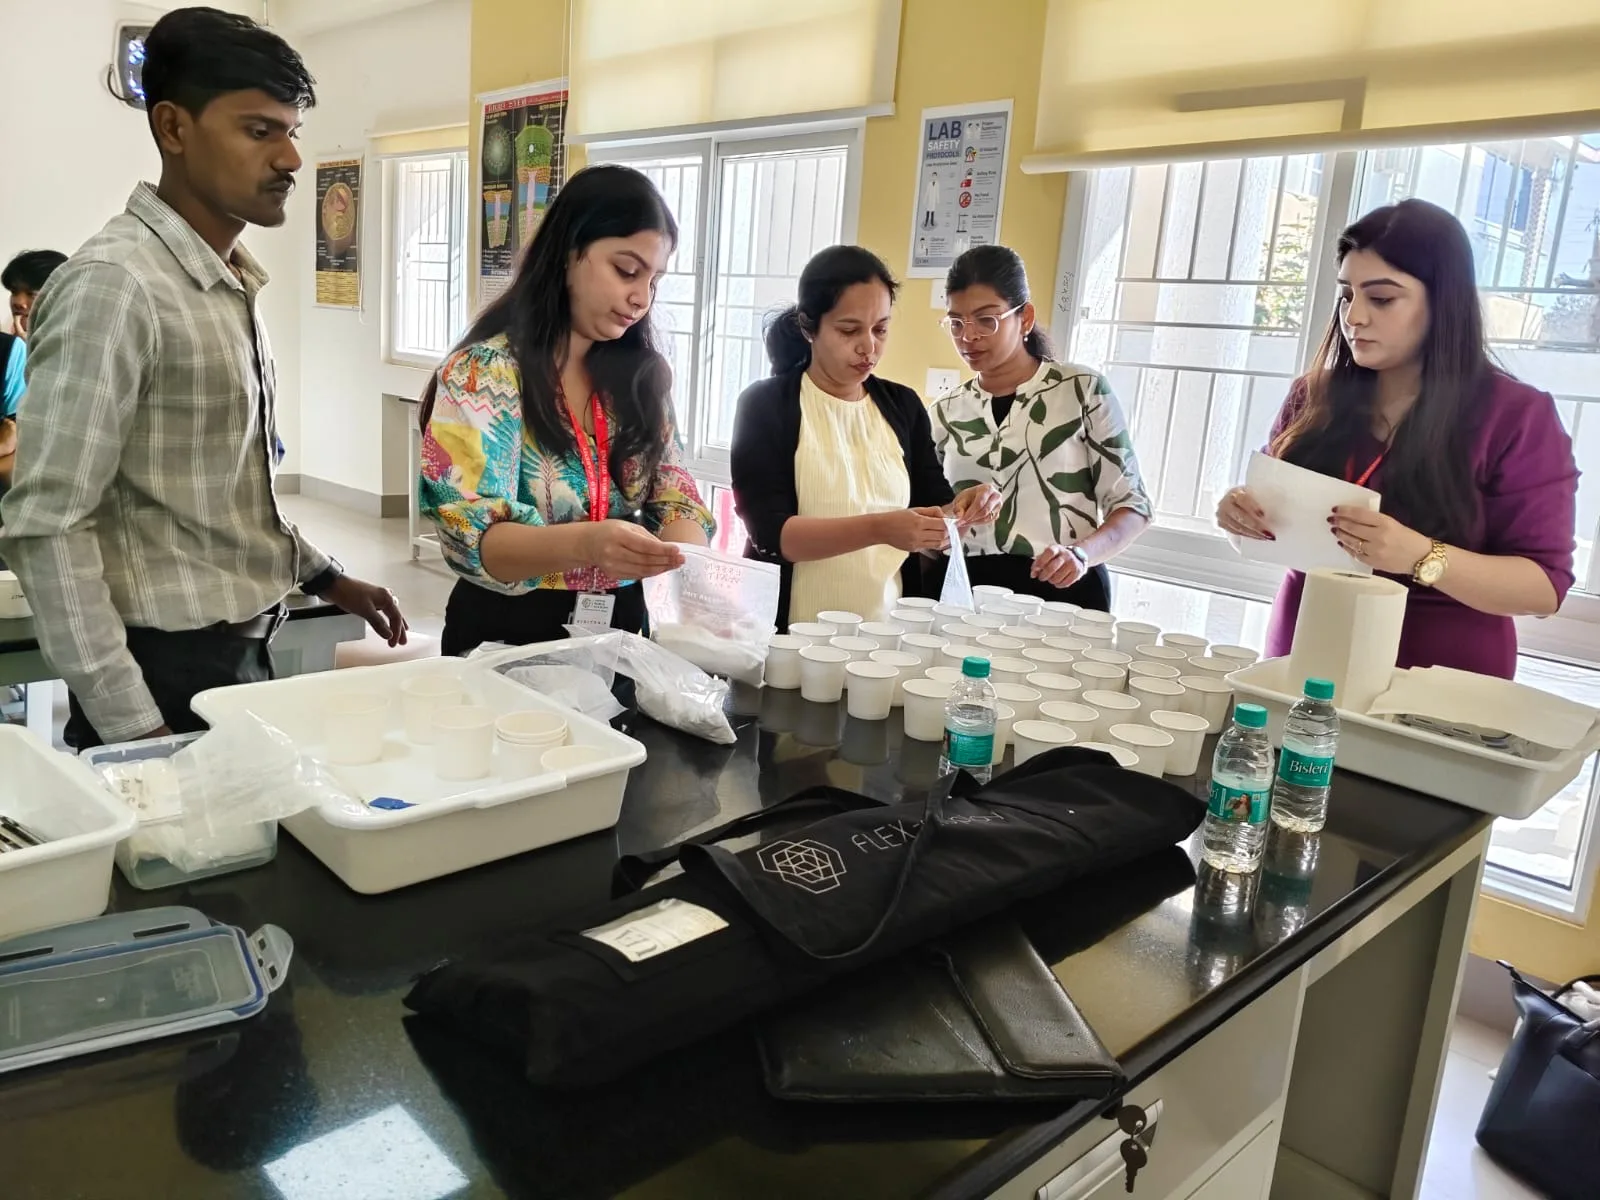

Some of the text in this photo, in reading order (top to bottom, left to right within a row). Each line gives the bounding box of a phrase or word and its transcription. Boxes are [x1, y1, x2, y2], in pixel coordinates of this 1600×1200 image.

[928, 120, 962, 140] LAB
[927, 139, 961, 151] SAFETY
[926, 151, 961, 160] PROTOCOLS
[583, 446, 594, 479] ACADEMY
[590, 481, 598, 506] WORLD
[1289, 760, 1329, 775] Bisleri
